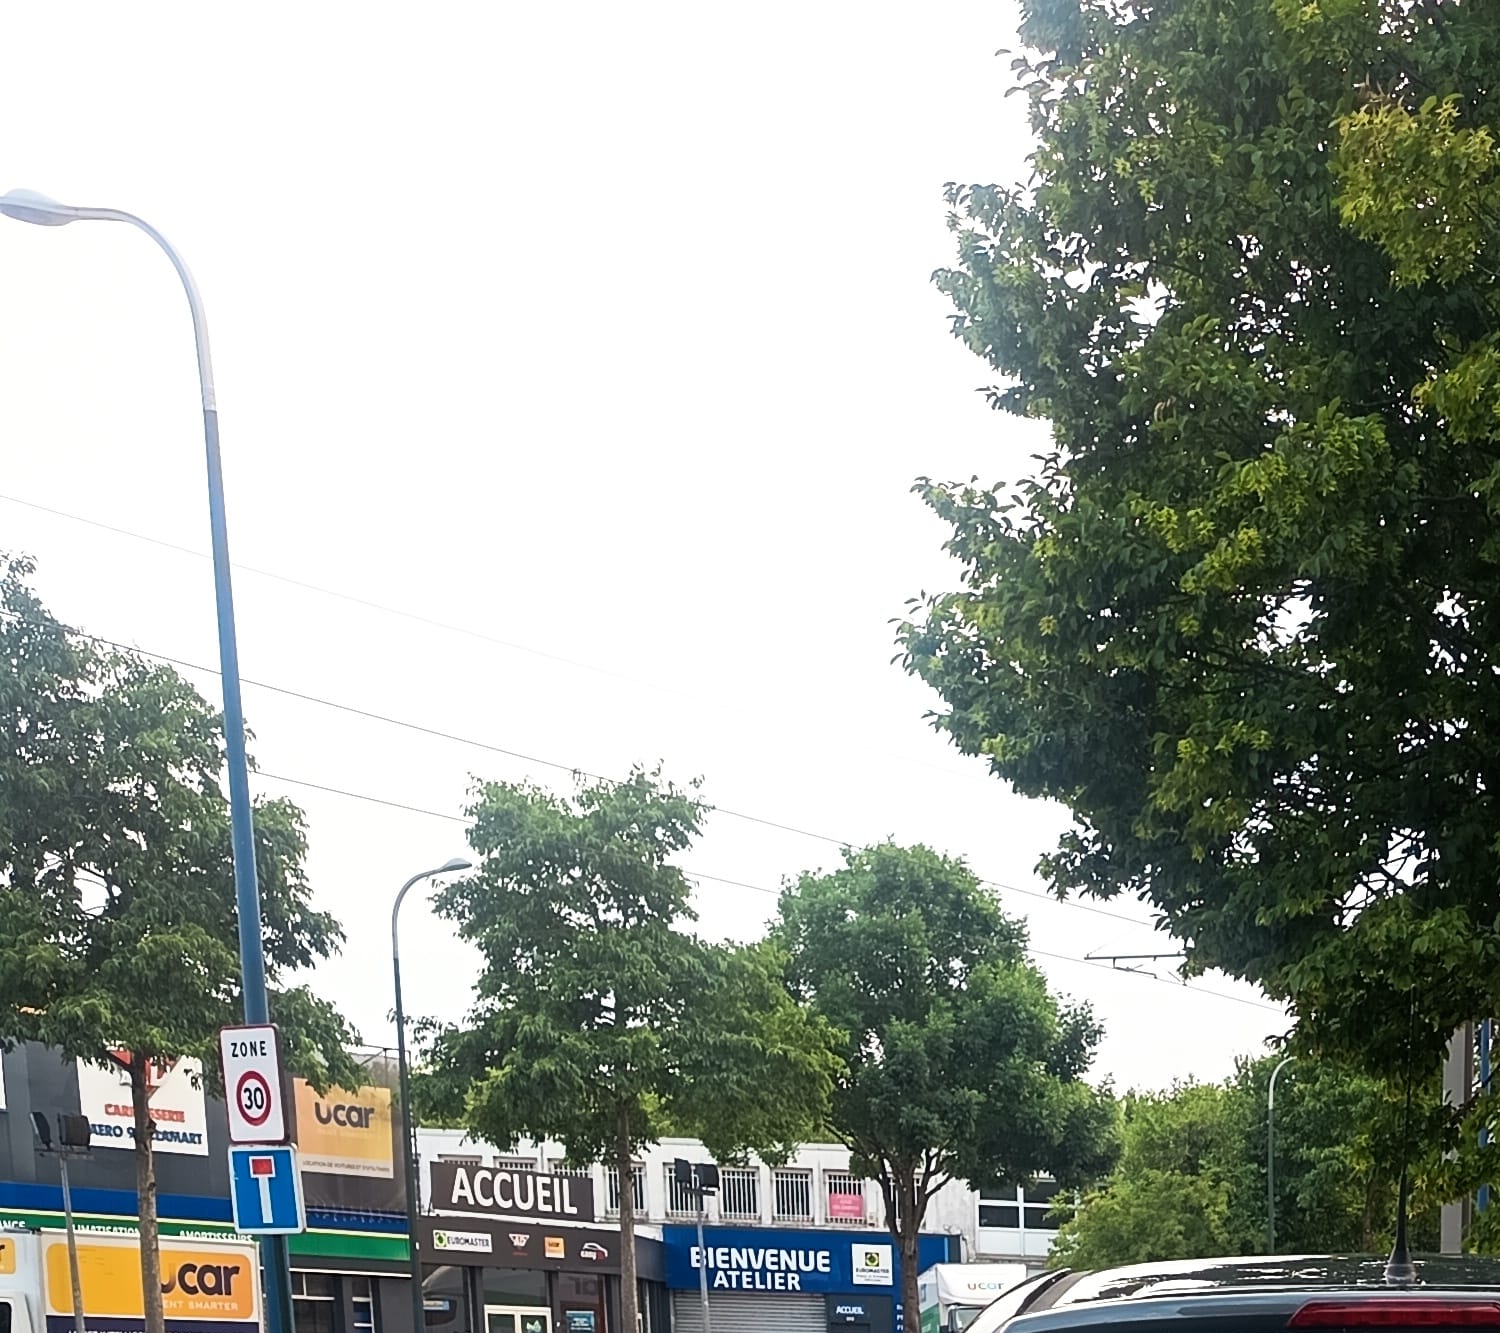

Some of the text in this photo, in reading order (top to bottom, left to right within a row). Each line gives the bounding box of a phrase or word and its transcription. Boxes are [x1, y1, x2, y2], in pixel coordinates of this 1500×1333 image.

[231, 1041, 267, 1057] ZONE
[243, 1087, 264, 1110] 30
[315, 1102, 374, 1128] ucar
[452, 1168, 578, 1214] ACCUEIL
[690, 1247, 831, 1273] BIENVENUE
[713, 1271, 801, 1290] ATELIER
[836, 1305, 864, 1315] ACCUEIL
